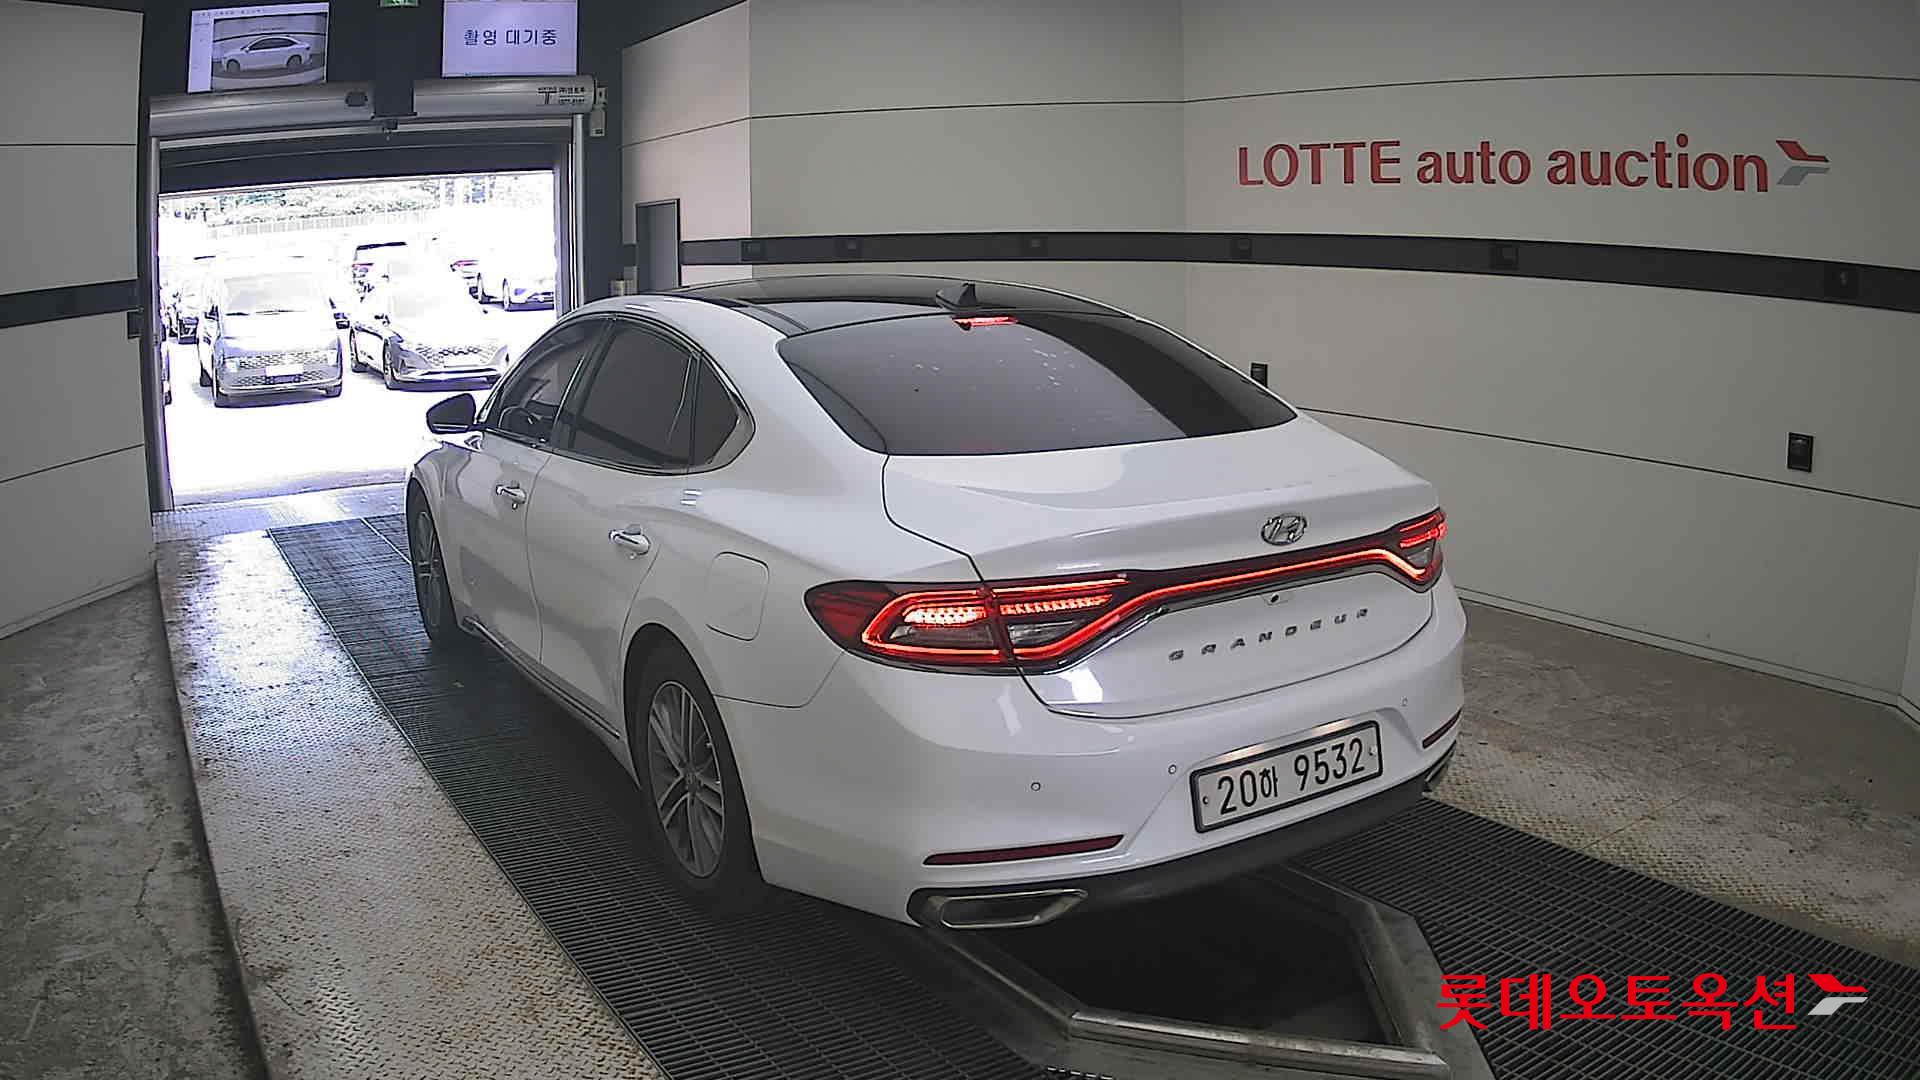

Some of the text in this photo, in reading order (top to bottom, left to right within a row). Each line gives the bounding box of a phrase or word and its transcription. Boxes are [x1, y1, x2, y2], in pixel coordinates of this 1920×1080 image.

[464, 29, 557, 46] 촬영 대기중
[1239, 133, 1768, 192] LOTTE auto auction
[1168, 608, 1368, 661] GRANDEUR
[1217, 737, 1365, 815] 20하 9532
